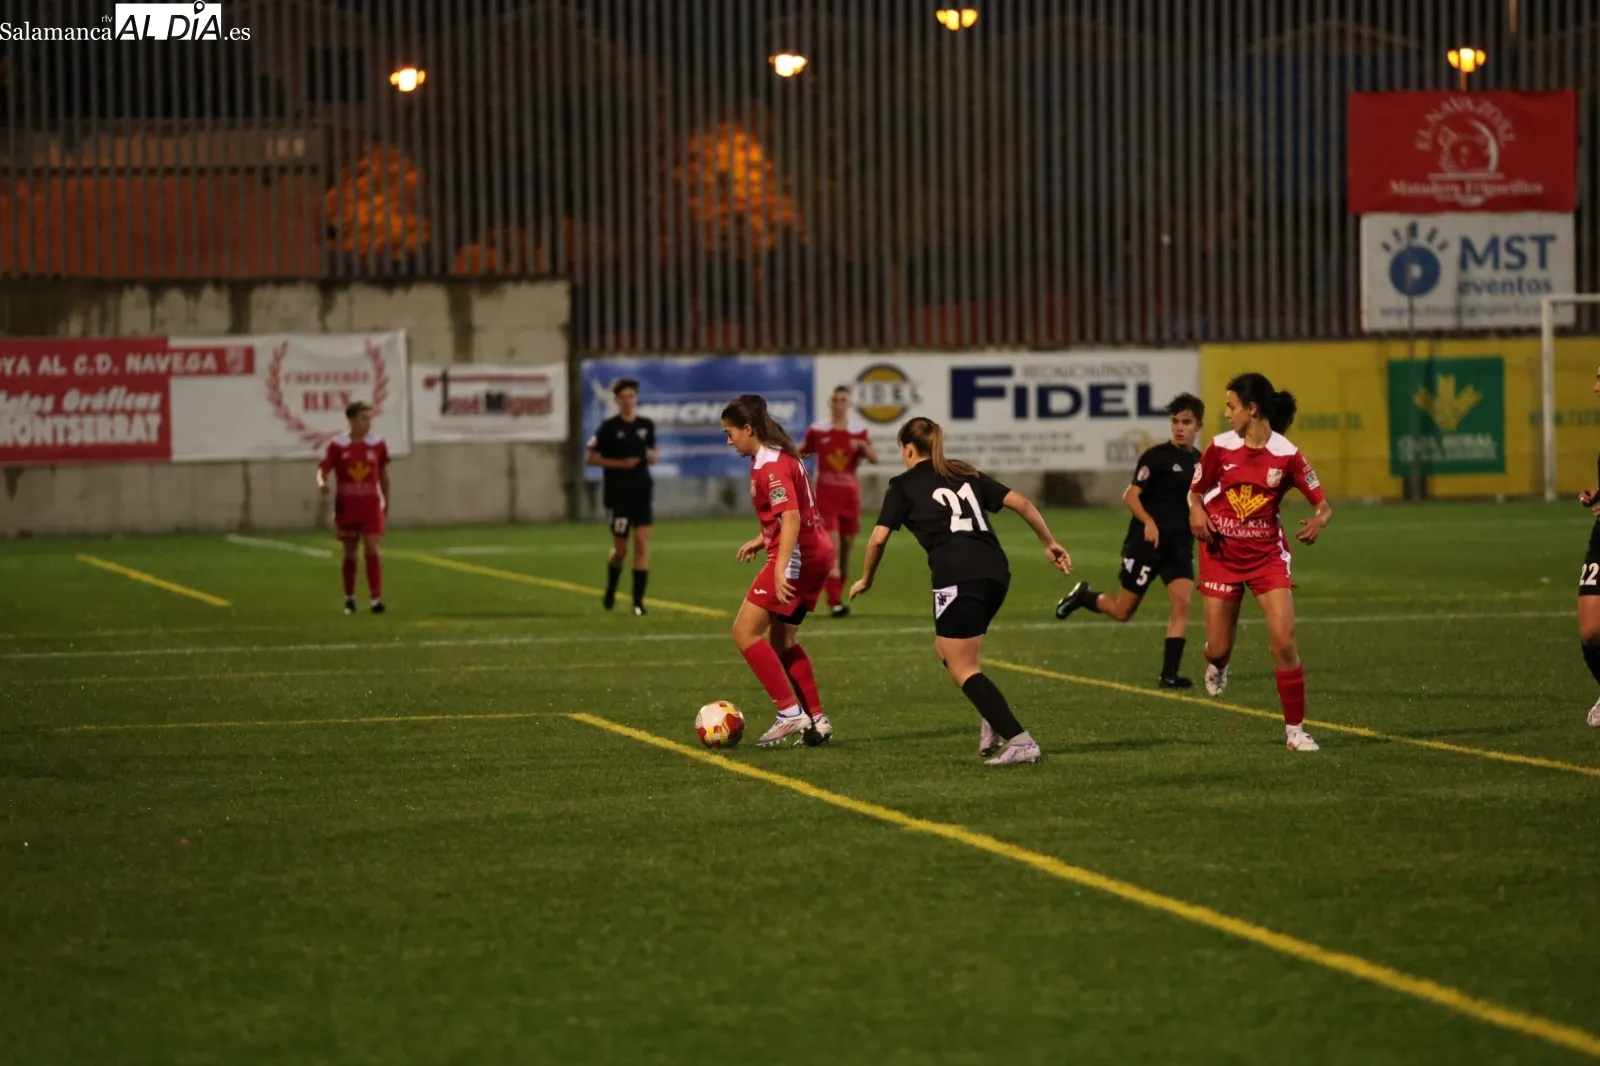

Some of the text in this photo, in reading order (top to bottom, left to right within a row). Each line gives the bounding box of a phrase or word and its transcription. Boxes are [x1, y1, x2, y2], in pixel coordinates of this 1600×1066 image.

[1459, 234, 1557, 272] MST
[1459, 277, 1553, 296] eventos
[0, 353, 31, 377] YA
[38, 354, 67, 376] AL
[126, 352, 218, 374] NAVEGA
[949, 365, 1167, 420] FIDEL
[932, 482, 988, 533] 21
[1136, 566, 1151, 586] 5
[1579, 562, 1600, 586] 22
